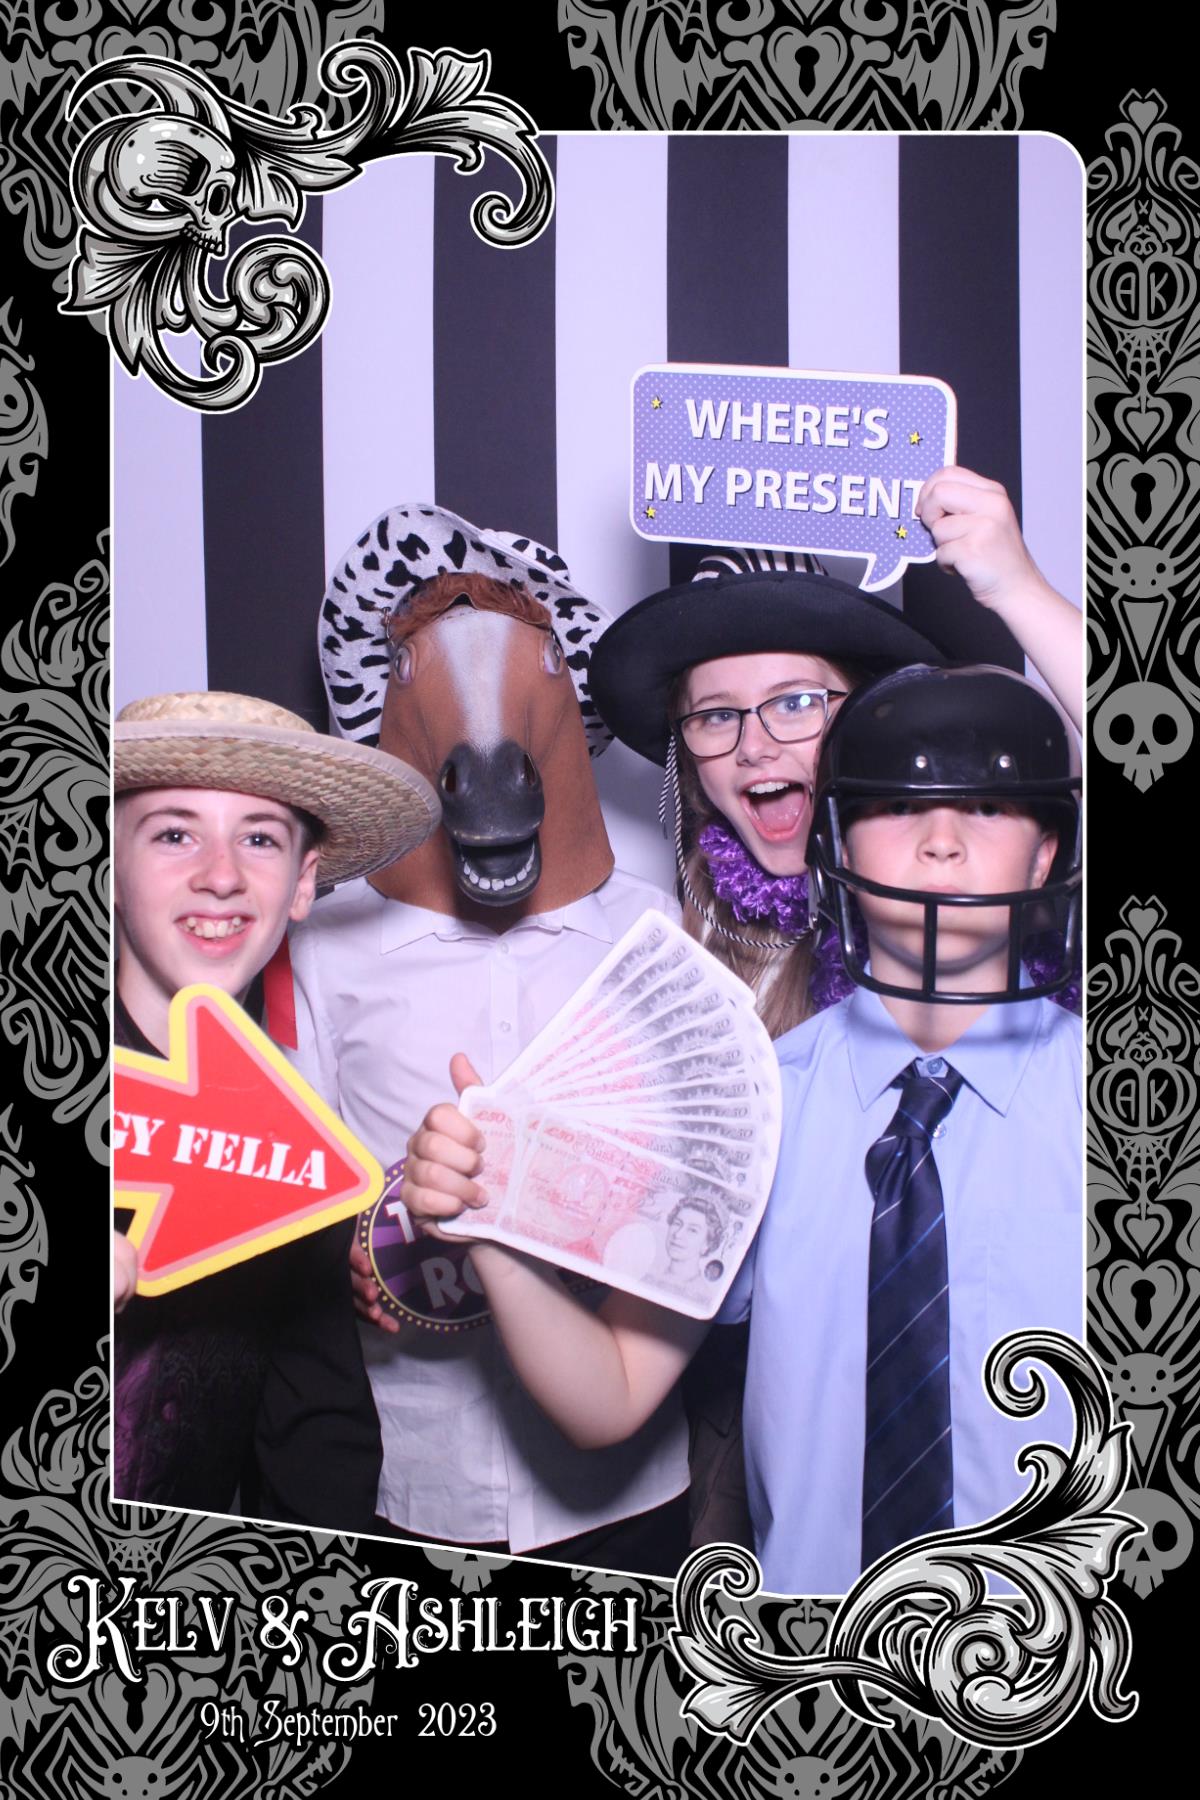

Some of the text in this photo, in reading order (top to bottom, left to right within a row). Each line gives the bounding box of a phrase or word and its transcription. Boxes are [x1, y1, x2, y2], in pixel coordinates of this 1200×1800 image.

[686, 398, 891, 450] WHERE'S
[644, 462, 926, 521] MY PRESENT
[172, 1123, 327, 1191] FELLA
